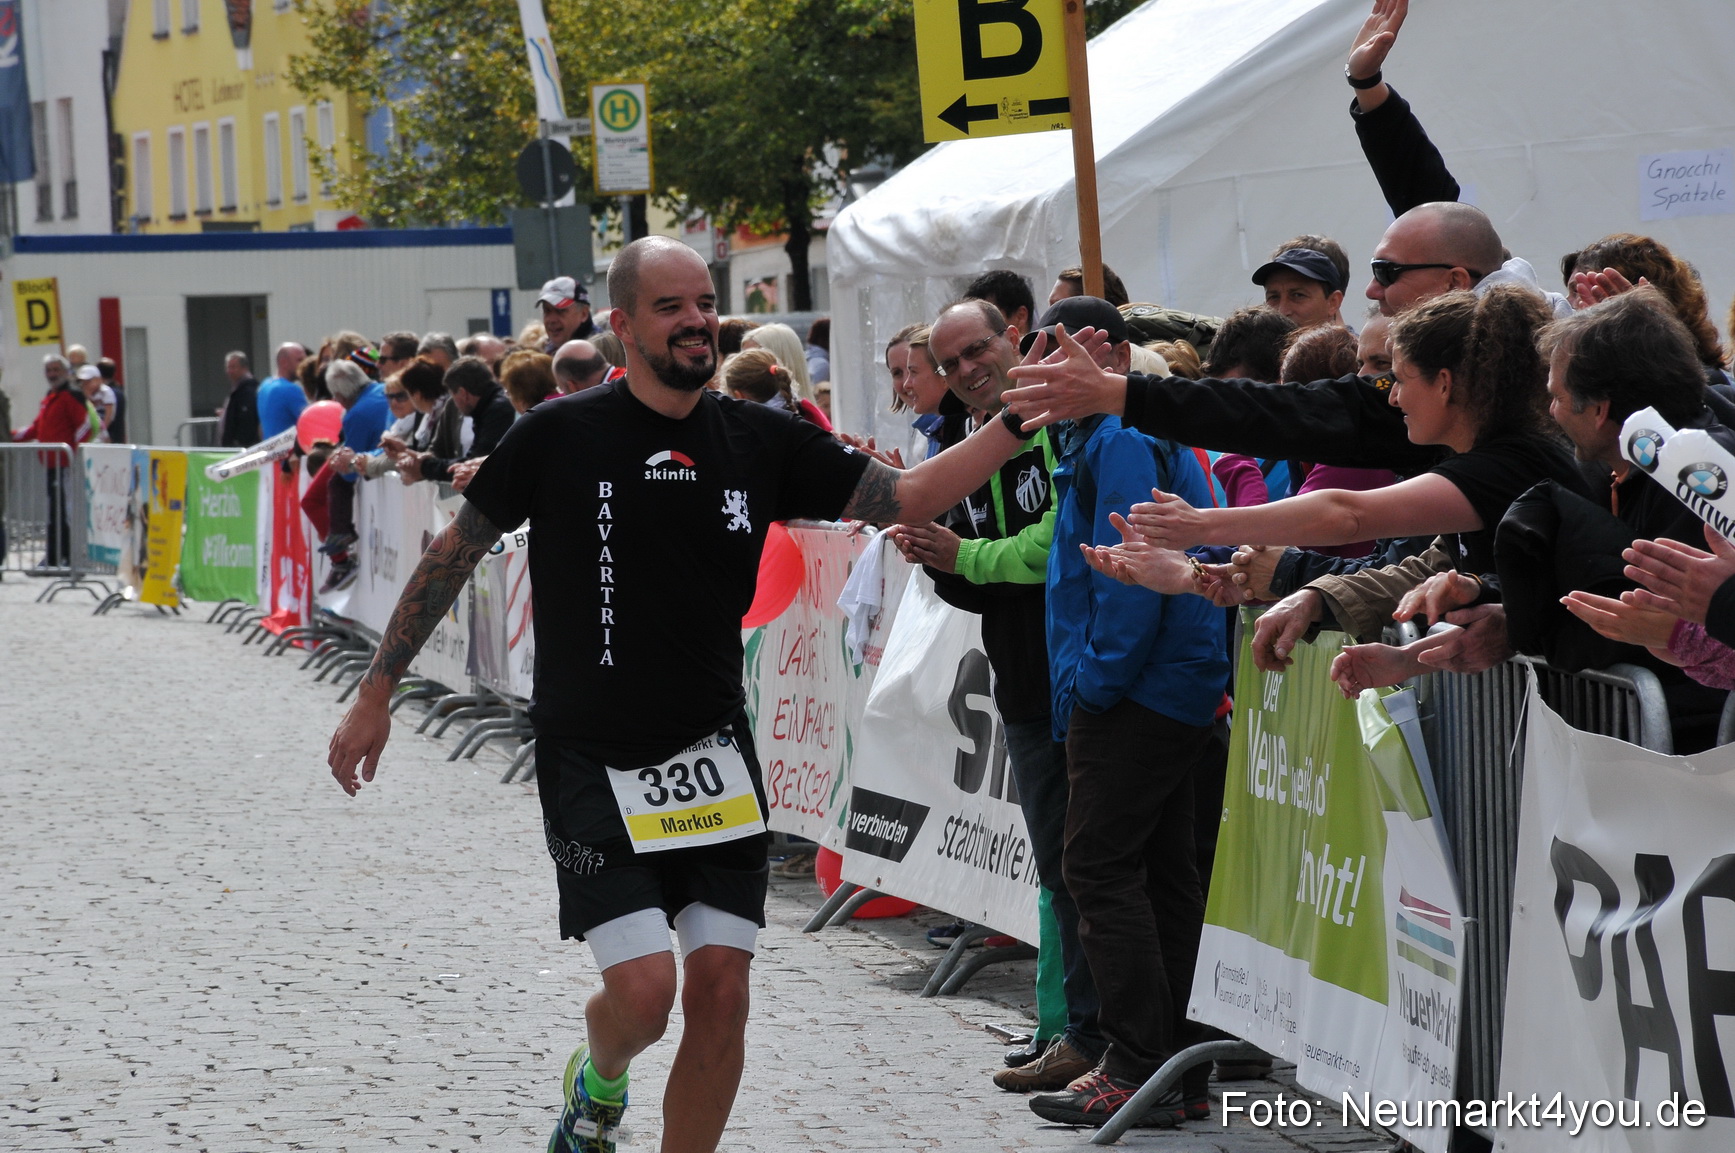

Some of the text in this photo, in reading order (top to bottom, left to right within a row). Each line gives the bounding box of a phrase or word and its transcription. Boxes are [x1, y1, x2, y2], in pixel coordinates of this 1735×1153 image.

[958, 0, 1043, 82] B
[174, 78, 205, 114] HOTEL
[610, 98, 630, 122] H
[1647, 153, 1724, 179] Gnocchi
[26, 299, 51, 331] D
[644, 468, 697, 481] skinfit
[597, 481, 615, 666] BAVARTRIA
[638, 757, 725, 807] 330
[660, 811, 724, 834] Markus
[850, 811, 909, 844] verbinden
[937, 809, 1026, 881] stadtwerke
